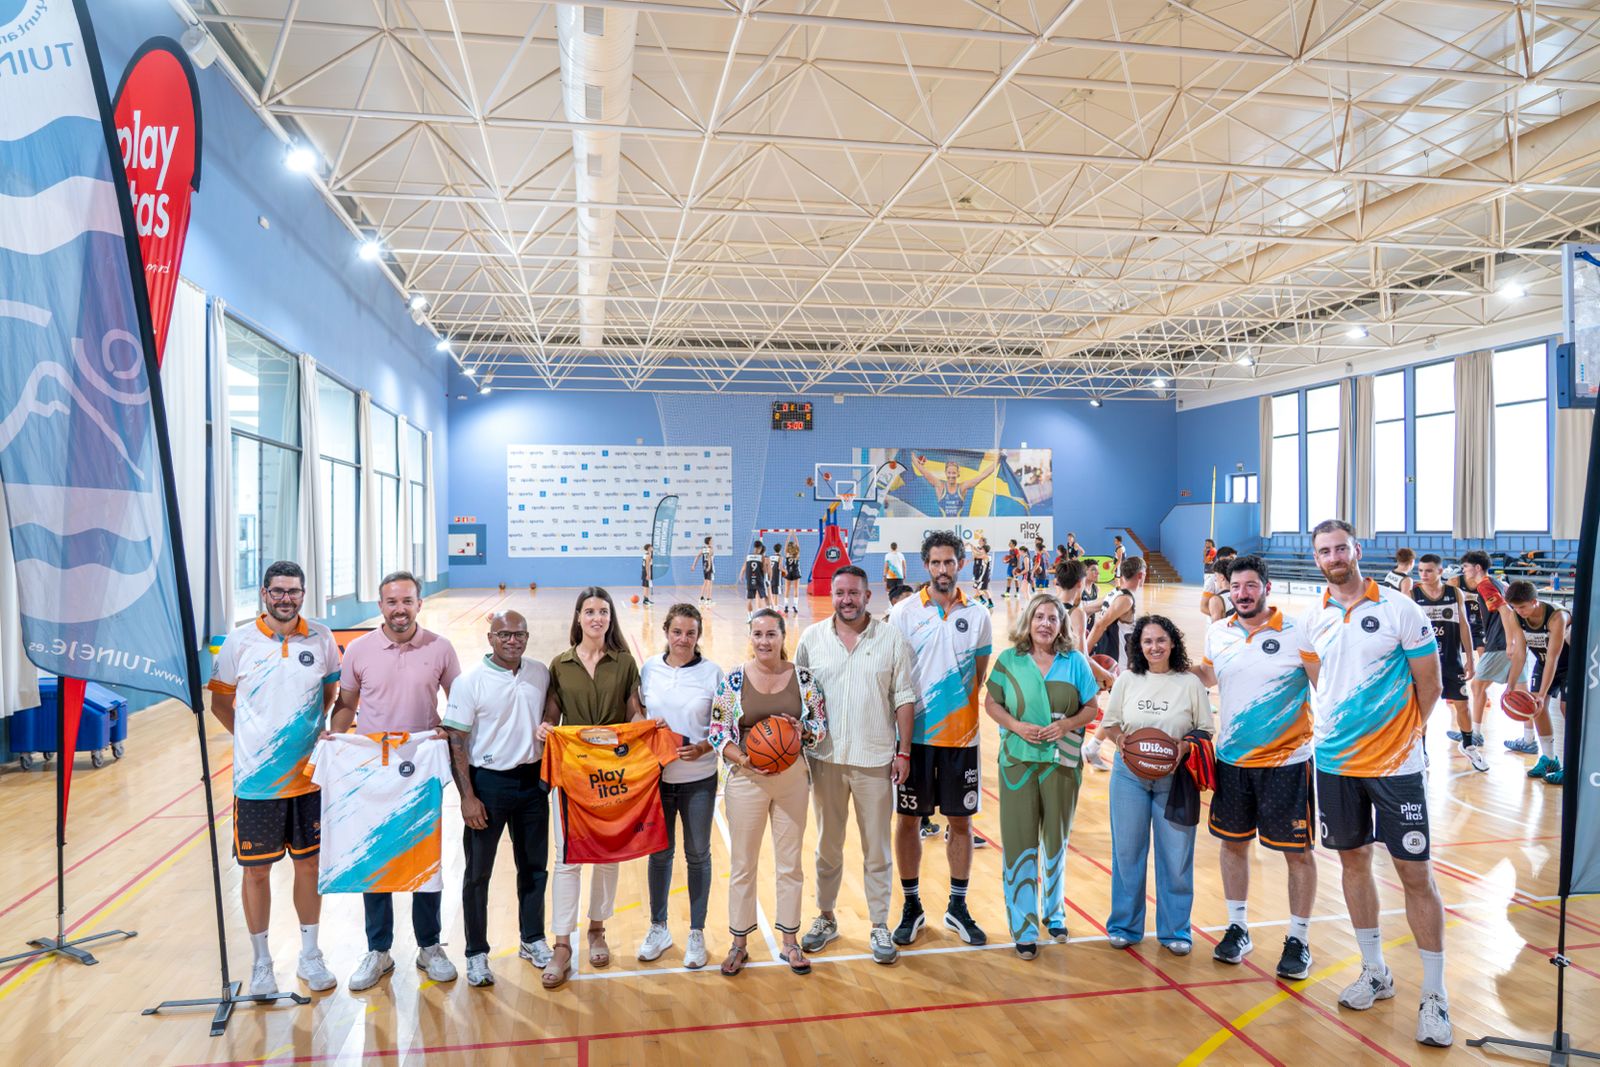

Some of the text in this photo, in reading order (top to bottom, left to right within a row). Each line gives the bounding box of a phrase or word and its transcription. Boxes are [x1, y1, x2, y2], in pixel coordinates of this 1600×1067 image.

[1020, 521, 1040, 533] play
[1138, 700, 1169, 712] SDLJ
[1139, 742, 1174, 756] Wilson
[589, 768, 626, 789] play
[598, 782, 628, 799] itas
[900, 794, 918, 810] 33
[1400, 802, 1422, 814] play
[1406, 812, 1423, 820] itas
